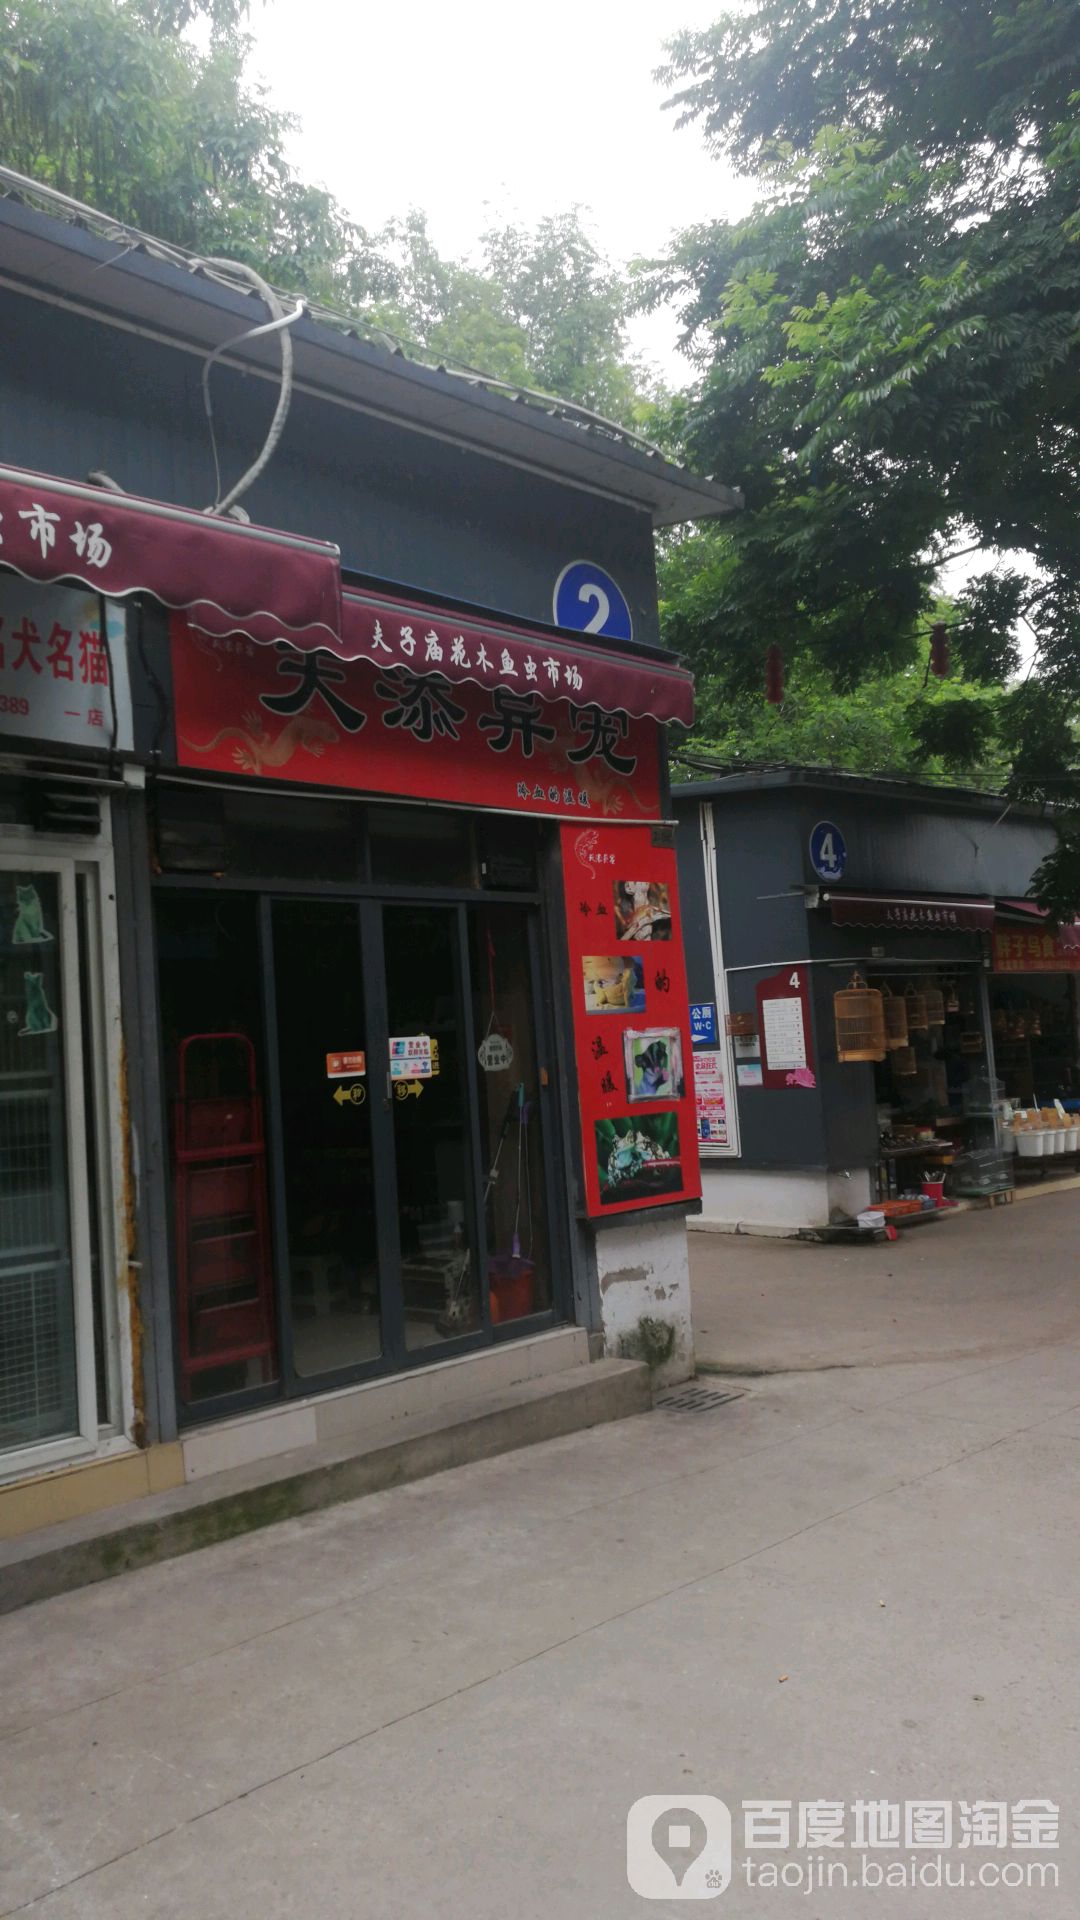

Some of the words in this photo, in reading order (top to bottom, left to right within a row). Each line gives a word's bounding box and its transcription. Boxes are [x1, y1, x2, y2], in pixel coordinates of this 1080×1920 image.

[0, 503, 113, 569] 市场
[578, 583, 611, 634] 2
[0, 617, 109, 687] 犬名猫
[371, 619, 584, 692] 夫子庙花木鱼虫市场
[819, 832, 837, 868] 4
[789, 971, 800, 989] 4
[691, 1006, 712, 1019] 公厕
